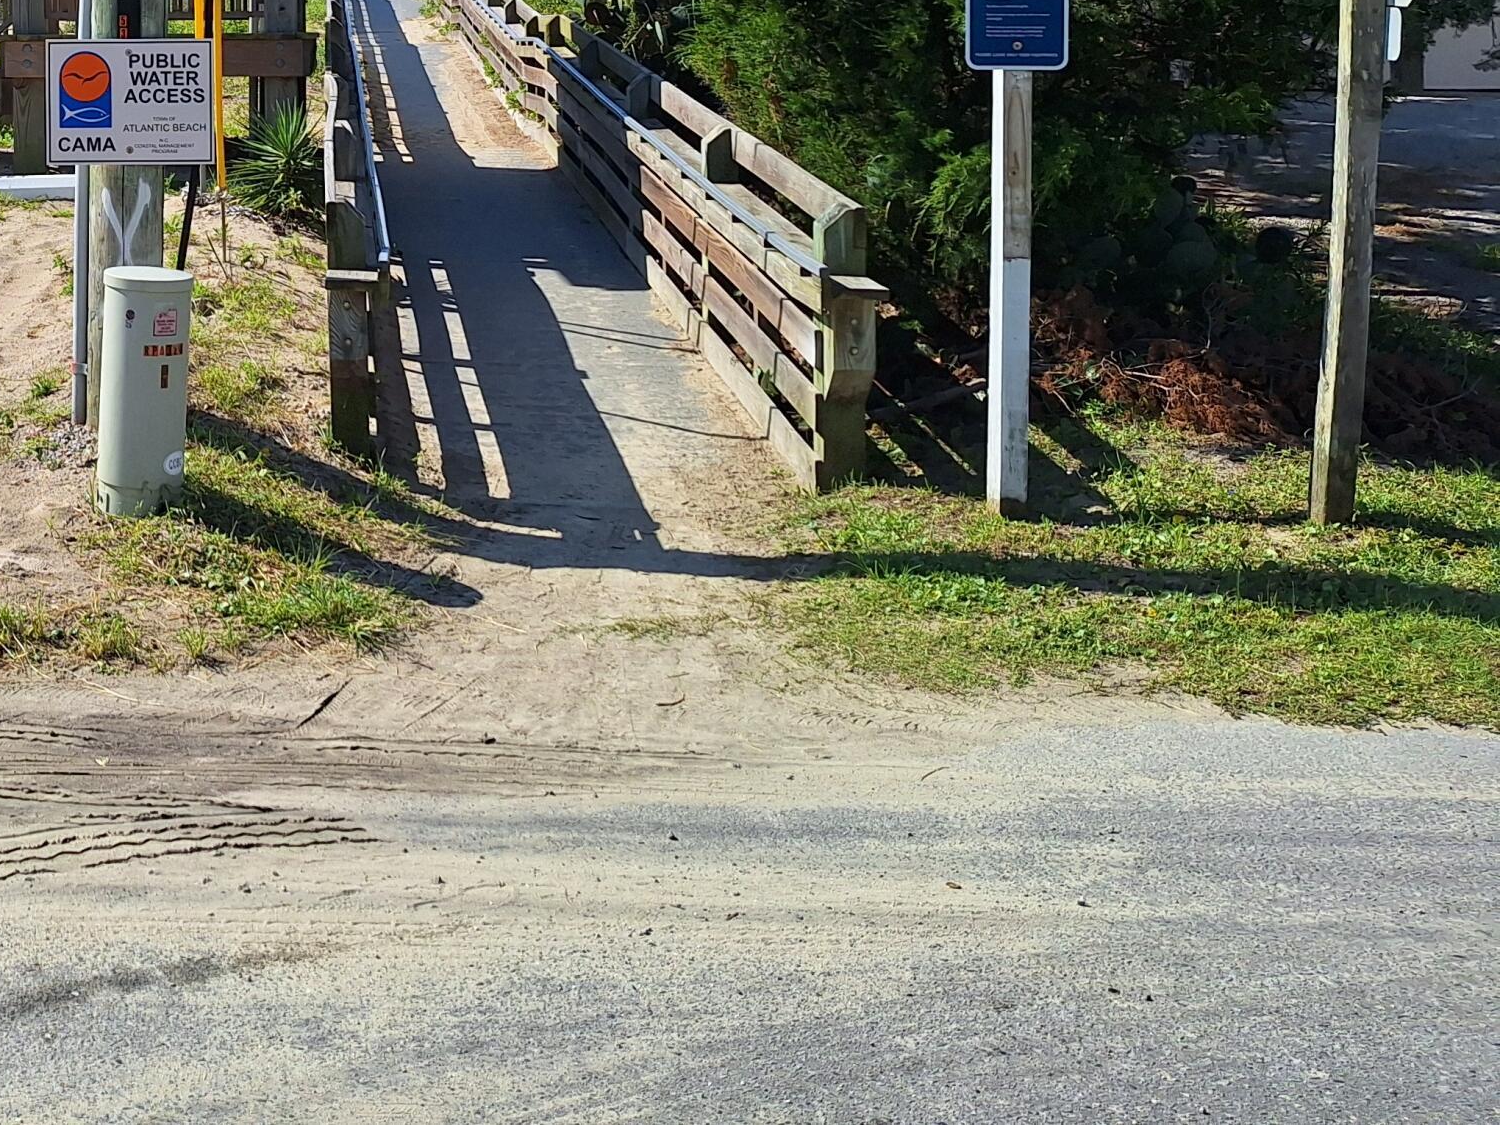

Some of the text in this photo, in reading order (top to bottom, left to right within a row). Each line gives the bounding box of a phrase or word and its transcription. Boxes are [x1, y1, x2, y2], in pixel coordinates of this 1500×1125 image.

[128, 53, 201, 69] PUBLIC
[129, 71, 200, 86] WATER
[123, 88, 206, 104] ACCESS
[122, 122, 207, 133] ATLANTIC BEACH
[58, 137, 116, 153] CAMA
